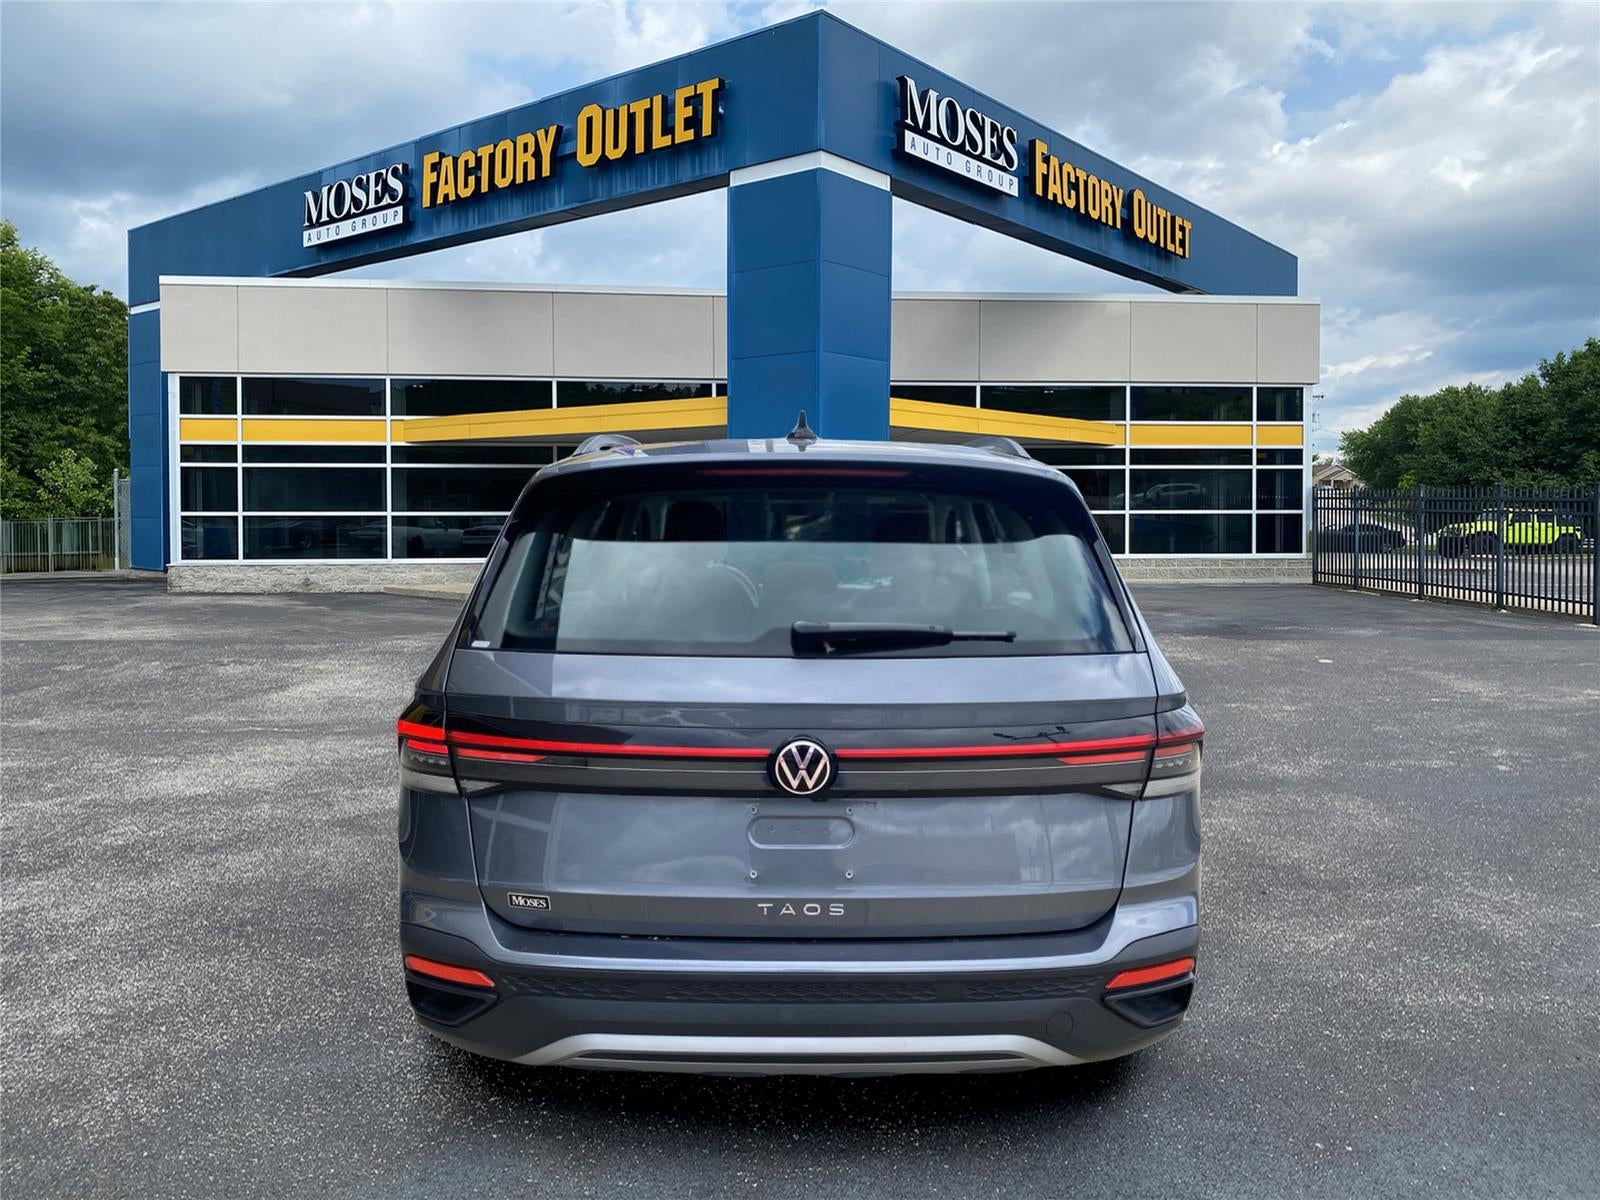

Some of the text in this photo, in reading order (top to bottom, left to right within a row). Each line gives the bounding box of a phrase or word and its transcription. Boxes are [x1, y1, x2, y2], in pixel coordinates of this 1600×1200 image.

[422, 77, 720, 208] FACTORY OUTLET
[904, 76, 1018, 171] MOSES
[910, 136, 1015, 190] AUTO GROUP
[303, 163, 403, 226] MOSES
[1035, 139, 1192, 258] FACTORY OUTLET
[307, 210, 399, 243] AUTO GROUP
[511, 895, 547, 908] MOSES
[757, 903, 845, 916] TAOS
